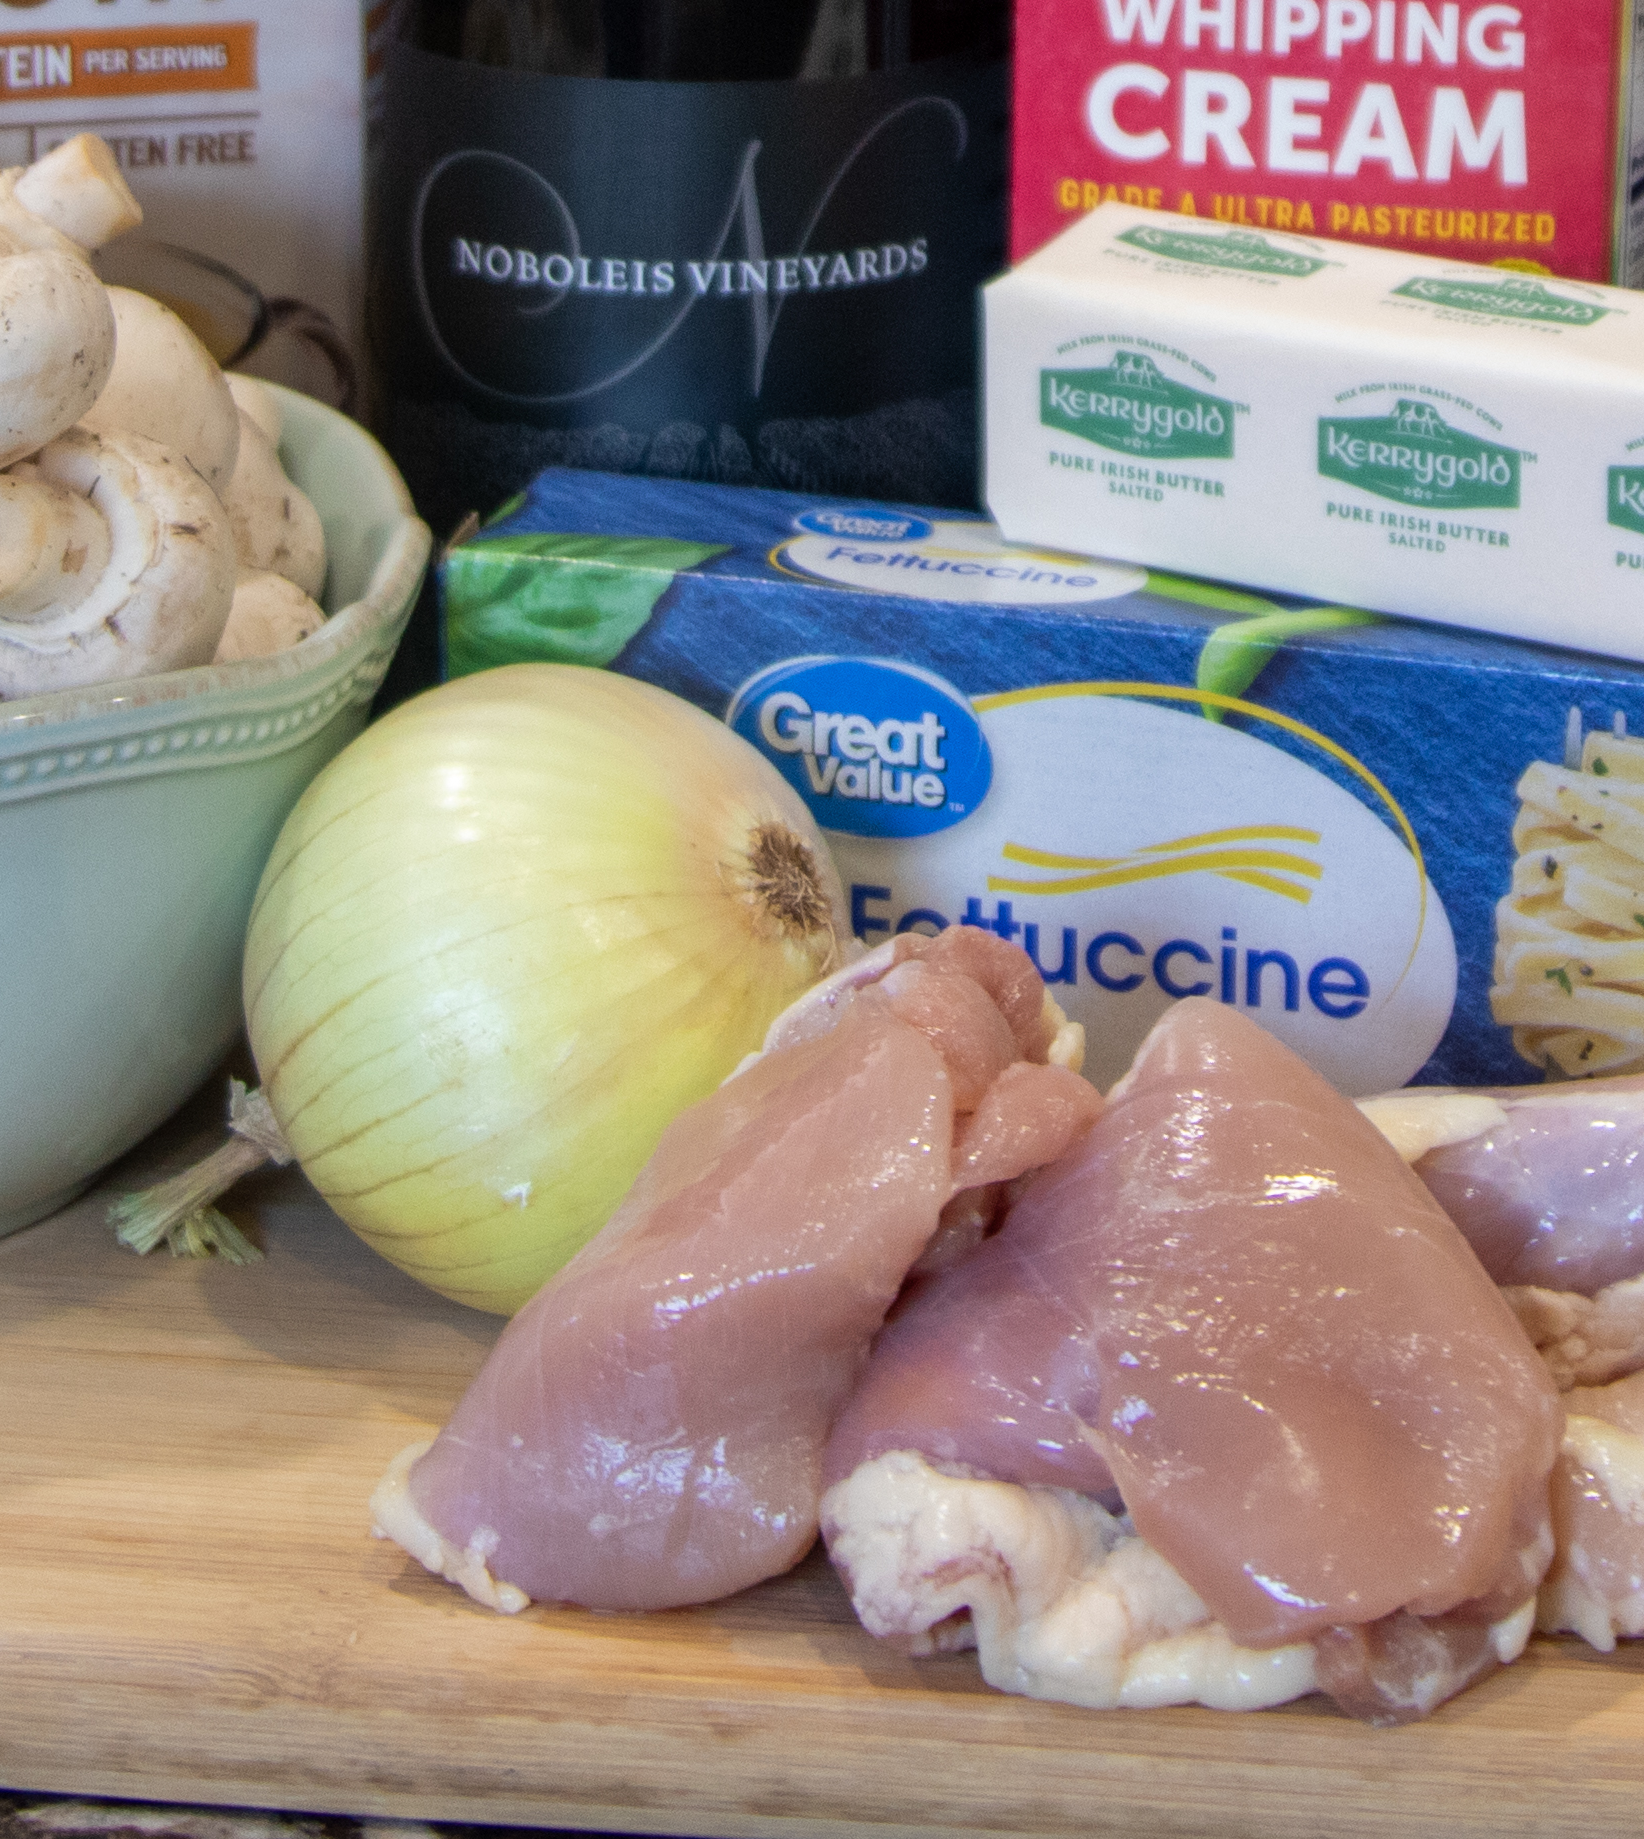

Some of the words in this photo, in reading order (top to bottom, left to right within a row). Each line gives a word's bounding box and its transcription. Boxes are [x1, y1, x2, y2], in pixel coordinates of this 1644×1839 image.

[84, 49, 129, 75] PER
[135, 44, 227, 72] SERVING
[1084, 62, 1529, 187] CREAM
[176, 130, 255, 166] FREE
[1180, 192, 1197, 217] A
[1214, 194, 1316, 230] ULTRA
[1332, 202, 1556, 245] PASTEURIZED
[455, 235, 676, 293] NOBOLEIS
[686, 237, 930, 294] VINEYARDS
[1079, 334, 1105, 347] FROM
[1107, 334, 1135, 344] IRISH
[1359, 383, 1386, 395] FROM
[1388, 382, 1417, 392] IRISH
[1049, 450, 1095, 472] PURE
[1101, 461, 1150, 483] IRISH
[1156, 470, 1226, 498] BUTTER
[1109, 481, 1165, 502] SALTED
[1326, 501, 1374, 523] PURE
[1380, 511, 1432, 534] IRISH
[1437, 521, 1511, 548] BUTTER
[1388, 531, 1447, 553] SALTED
[827, 545, 1099, 589] Fettuccine
[759, 690, 947, 772] Great
[802, 752, 946, 809] Value
